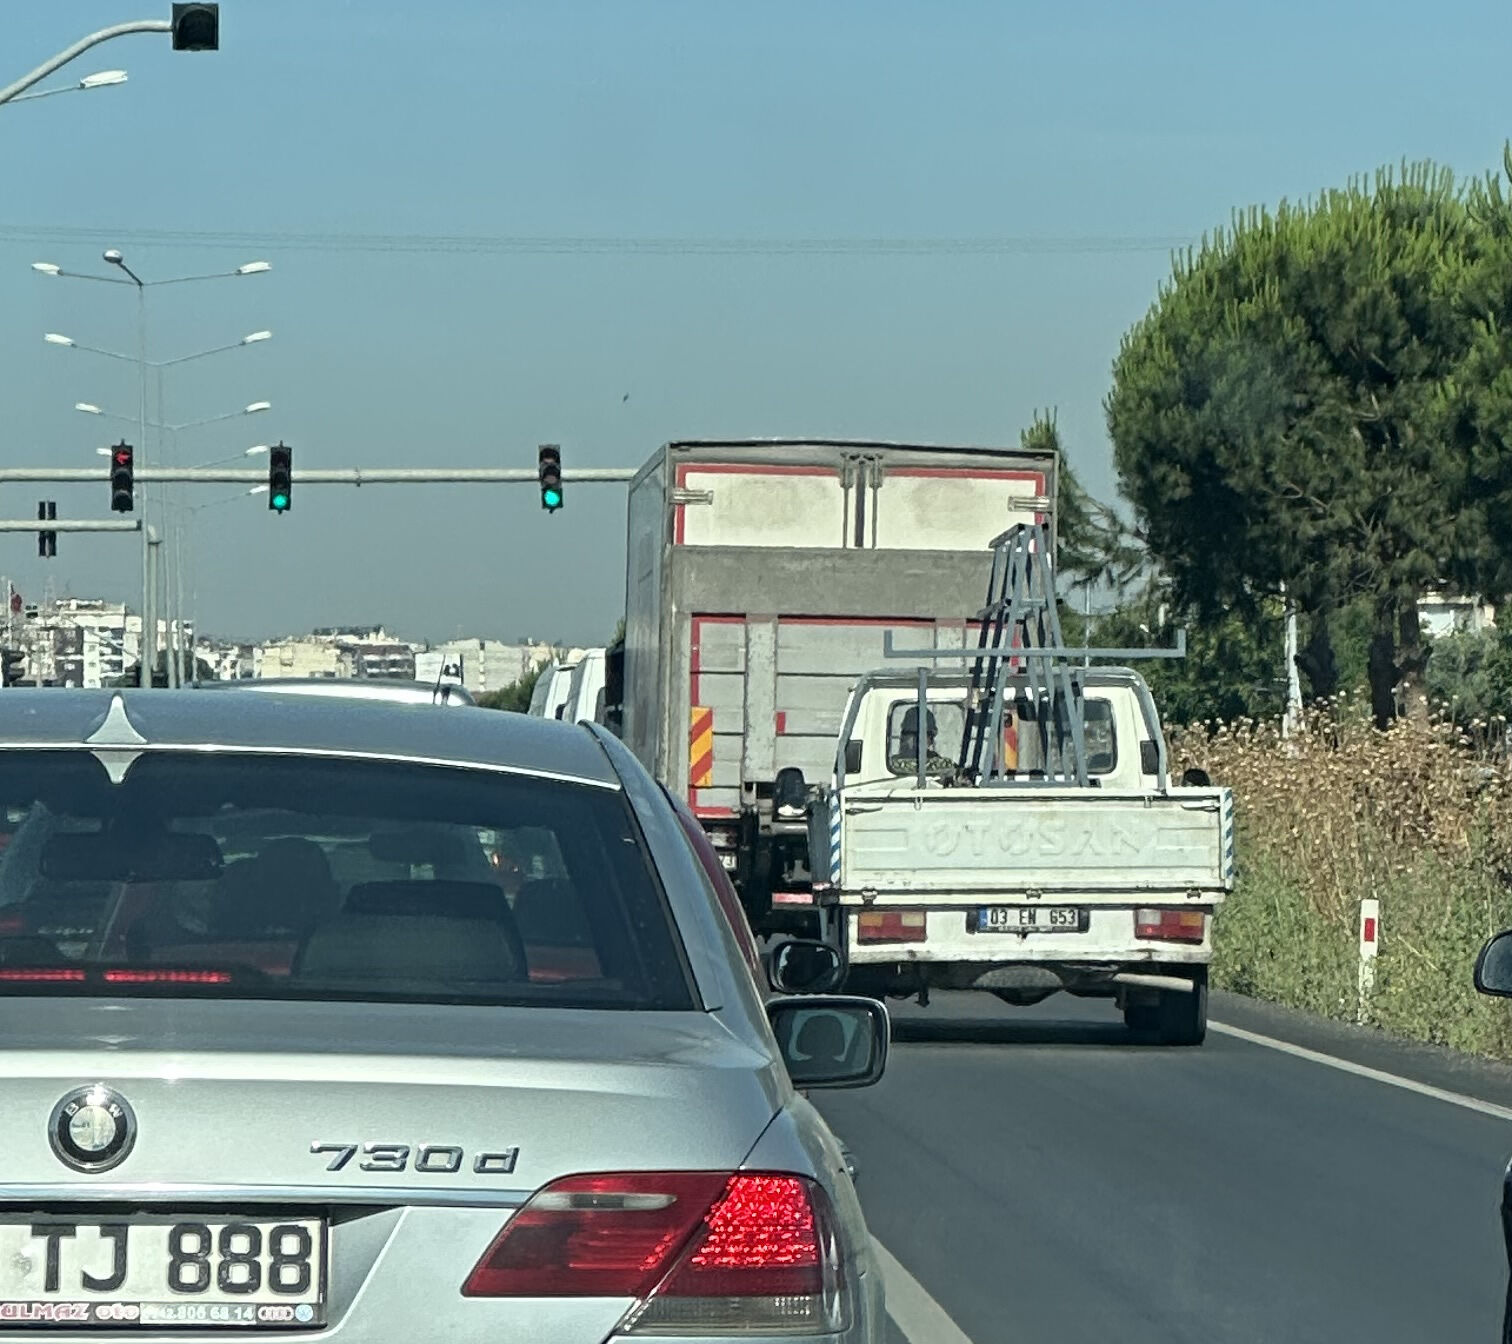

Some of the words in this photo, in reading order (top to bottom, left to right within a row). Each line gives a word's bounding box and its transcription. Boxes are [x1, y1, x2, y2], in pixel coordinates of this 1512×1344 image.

[990, 907, 1007, 925] 03
[1050, 907, 1076, 925] 653
[309, 1139, 520, 1174] 730d
[31, 1223, 128, 1293] TJ
[167, 1222, 312, 1295] 888
